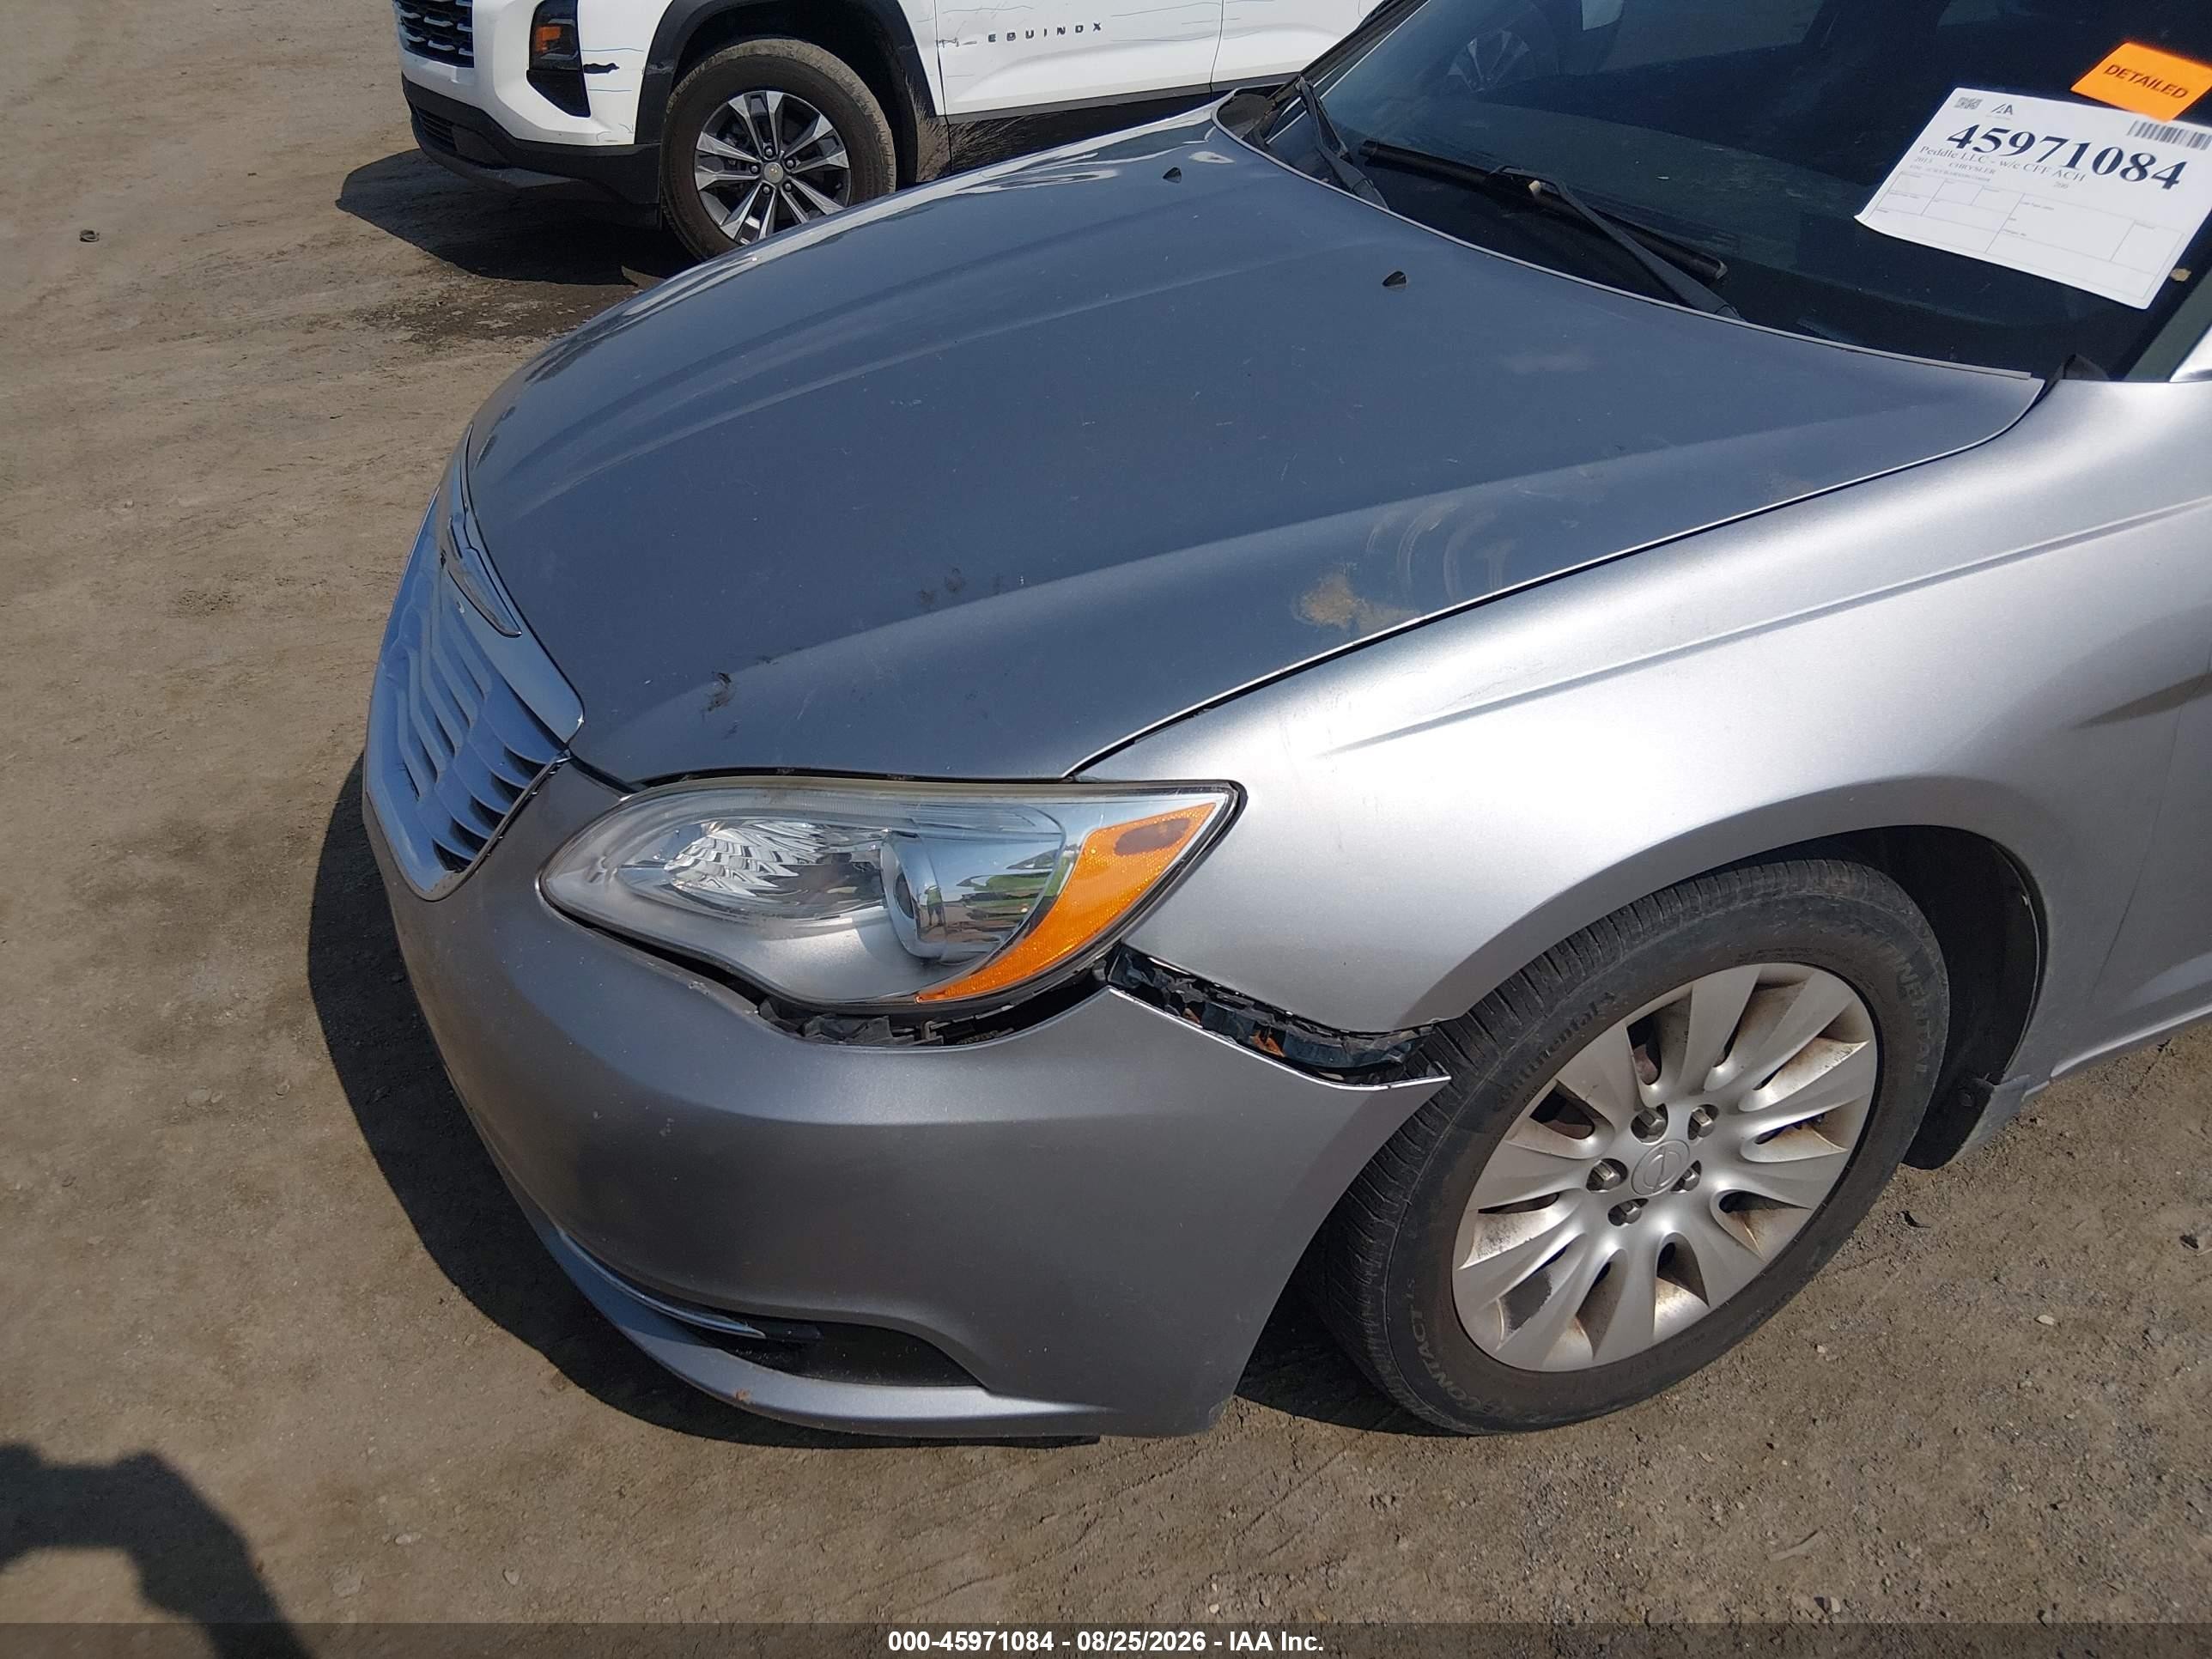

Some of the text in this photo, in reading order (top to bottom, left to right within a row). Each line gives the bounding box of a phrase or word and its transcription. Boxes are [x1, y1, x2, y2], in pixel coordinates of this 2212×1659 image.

[988, 22, 1102, 43] EQUINOX
[2103, 64, 2189, 99] DETAILED
[1919, 145, 1957, 159] Peddle
[1960, 152, 1990, 164] LLC
[2052, 169, 2087, 183] ACH
[1946, 124, 2187, 190] 45971084
[1948, 161, 1996, 174] CHRYSLER
